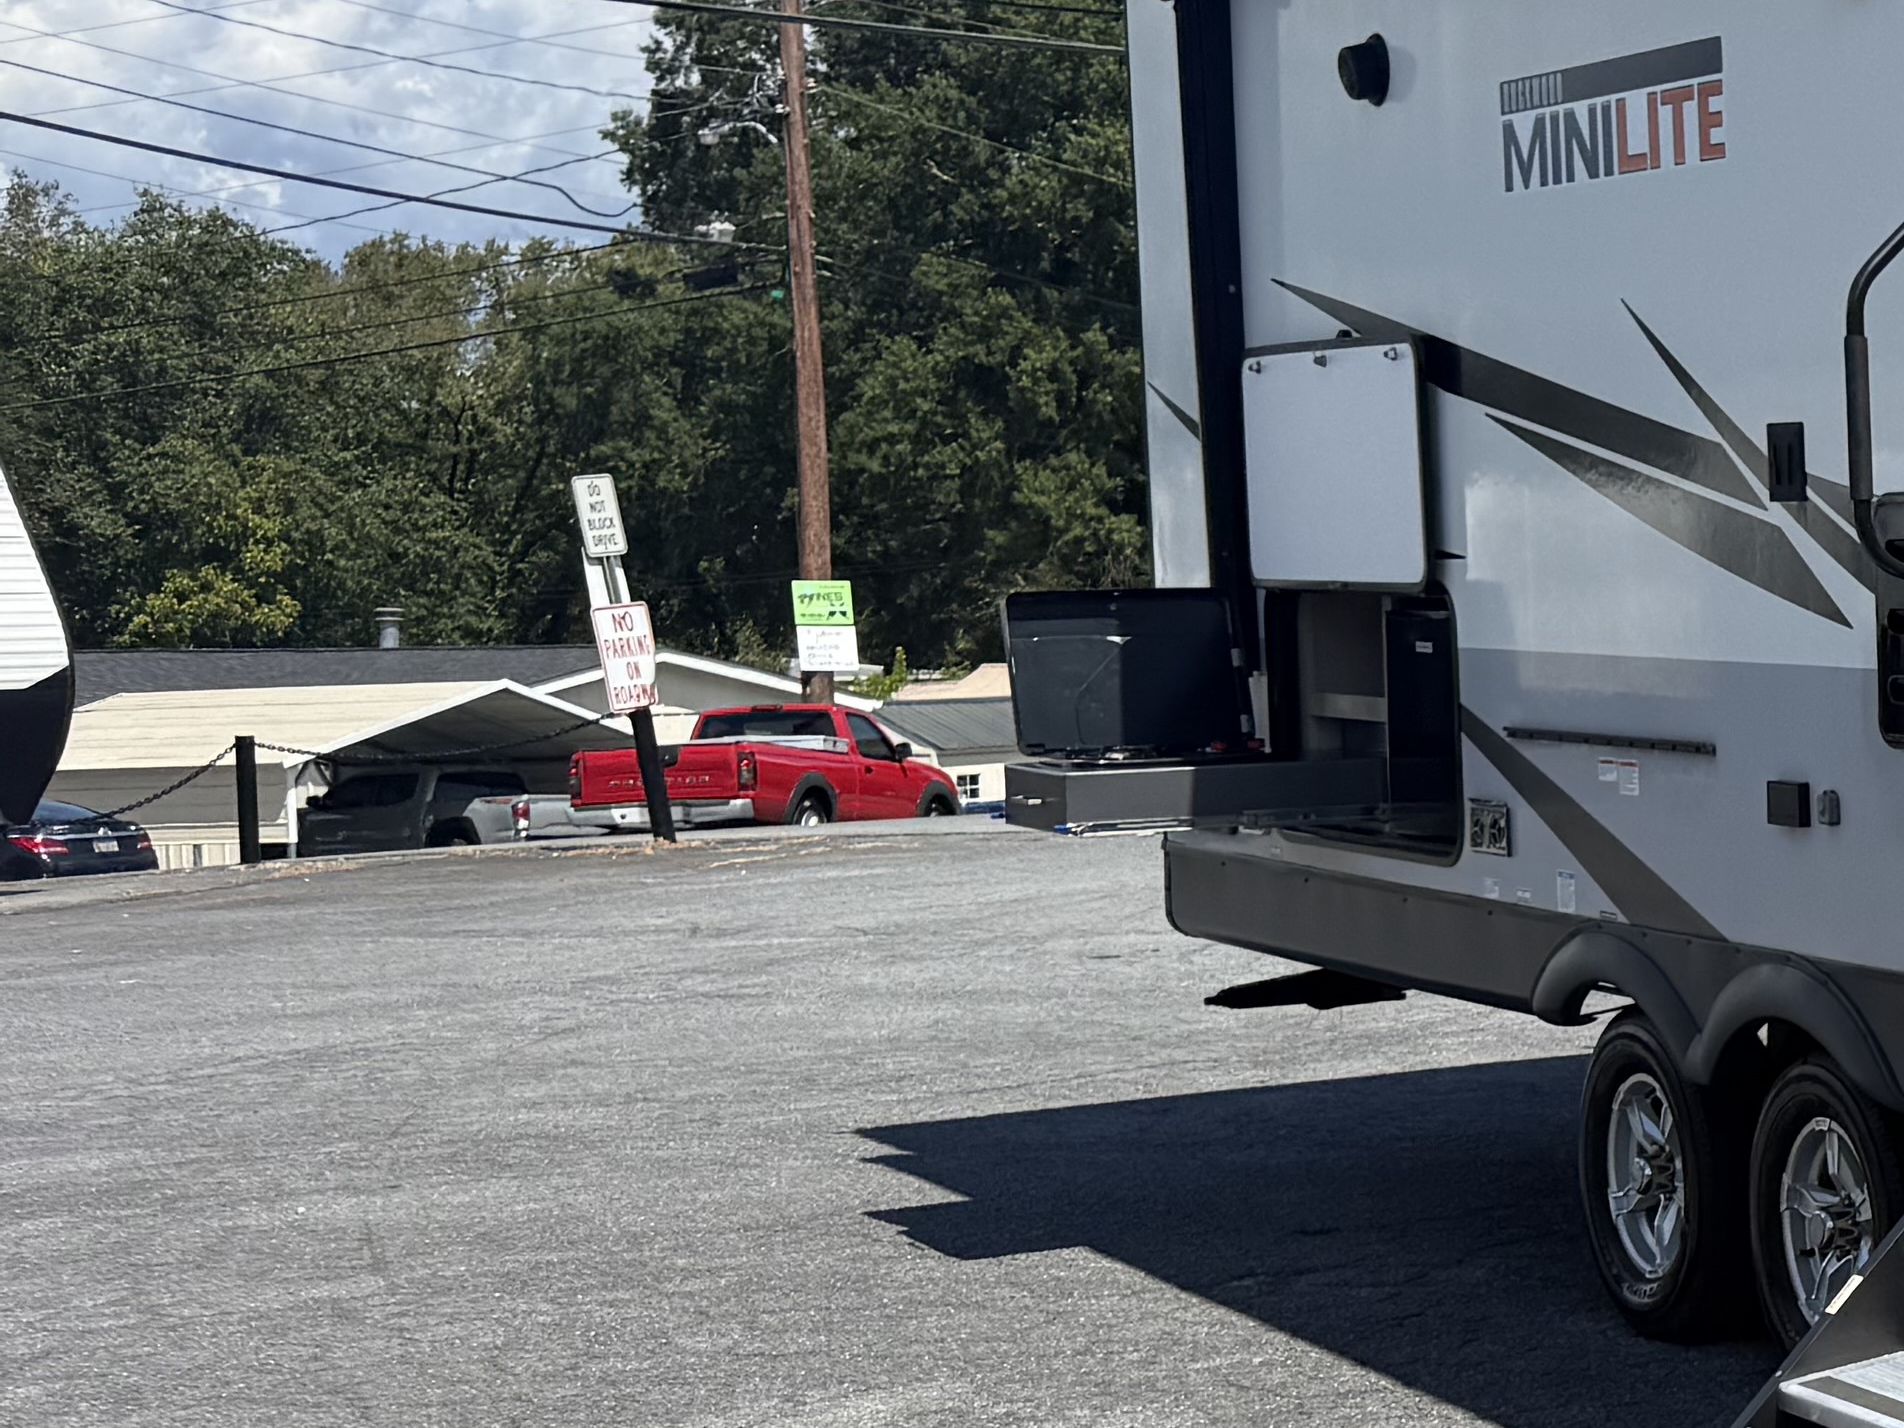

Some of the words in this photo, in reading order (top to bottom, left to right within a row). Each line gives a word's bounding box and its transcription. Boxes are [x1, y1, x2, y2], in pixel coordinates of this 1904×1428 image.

[1502, 79, 1726, 193] MINILITE
[588, 500, 606, 514] NOT
[587, 517, 616, 531] BLOCK
[592, 533, 619, 550] DRIVE
[611, 611, 634, 633] NO
[626, 661, 642, 681] ON
